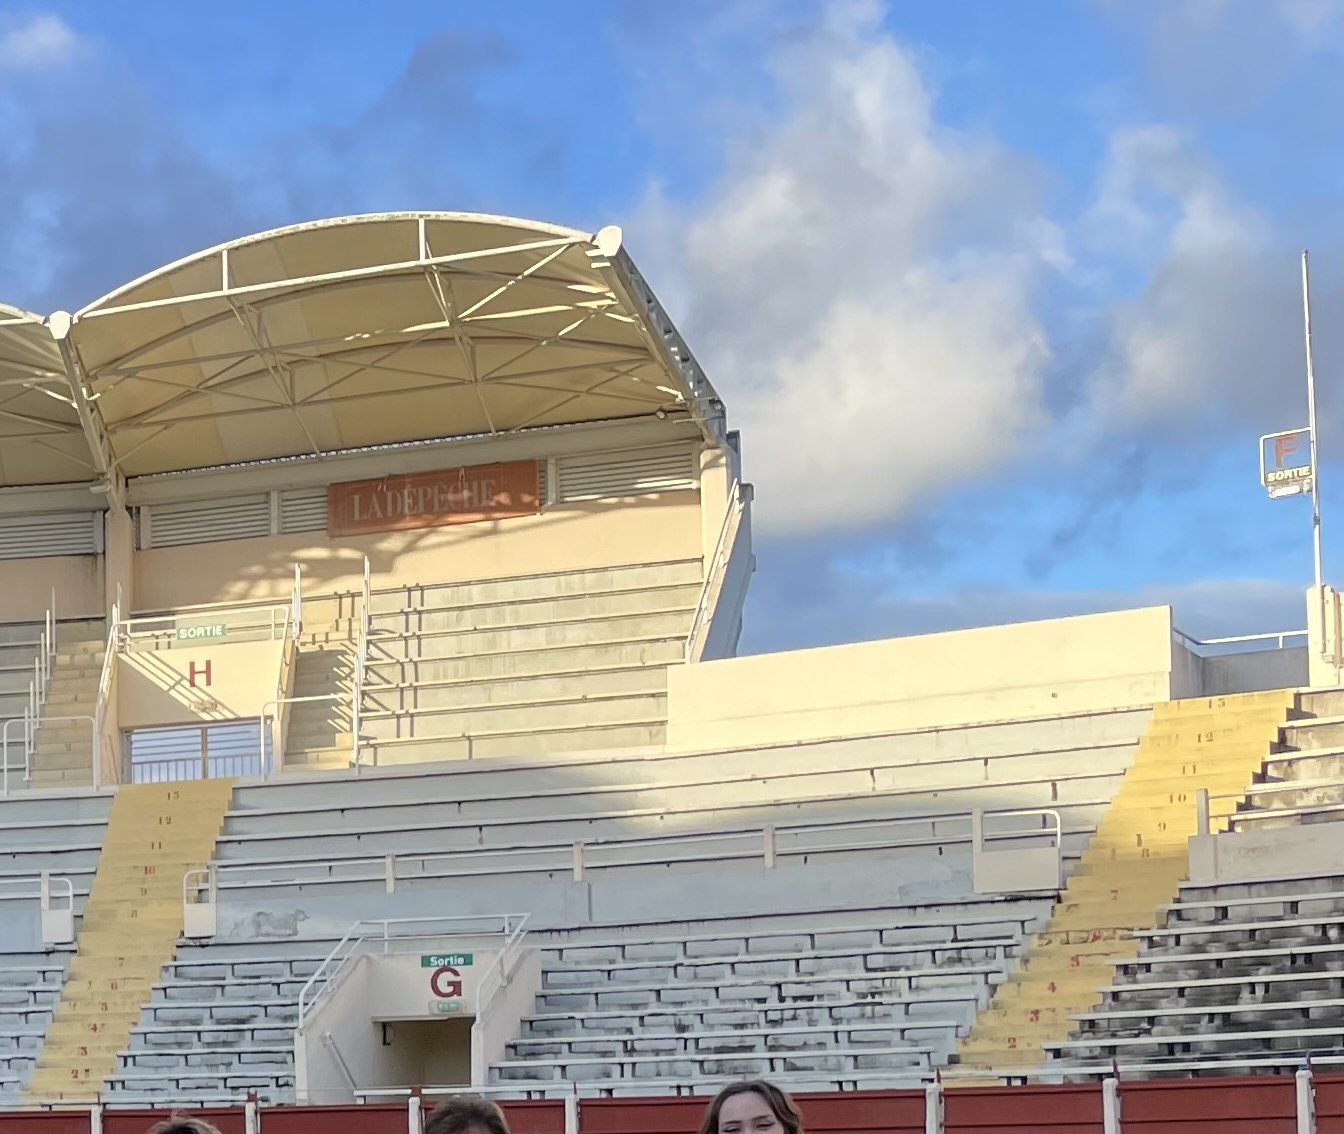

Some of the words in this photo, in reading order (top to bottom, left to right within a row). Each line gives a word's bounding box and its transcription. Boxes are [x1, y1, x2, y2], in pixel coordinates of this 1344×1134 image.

[1275, 434, 1297, 468] F
[1267, 466, 1310, 482] SORTIE
[353, 494, 384, 521] LA
[179, 625, 223, 639] SORTIE
[189, 660, 212, 688] H
[144, 866, 155, 875] 10
[430, 955, 465, 967] Sortie
[431, 967, 462, 998] G
[1048, 982, 1057, 992] 4
[1008, 1037, 1017, 1048] 2
[71, 1069, 79, 1078] 2
